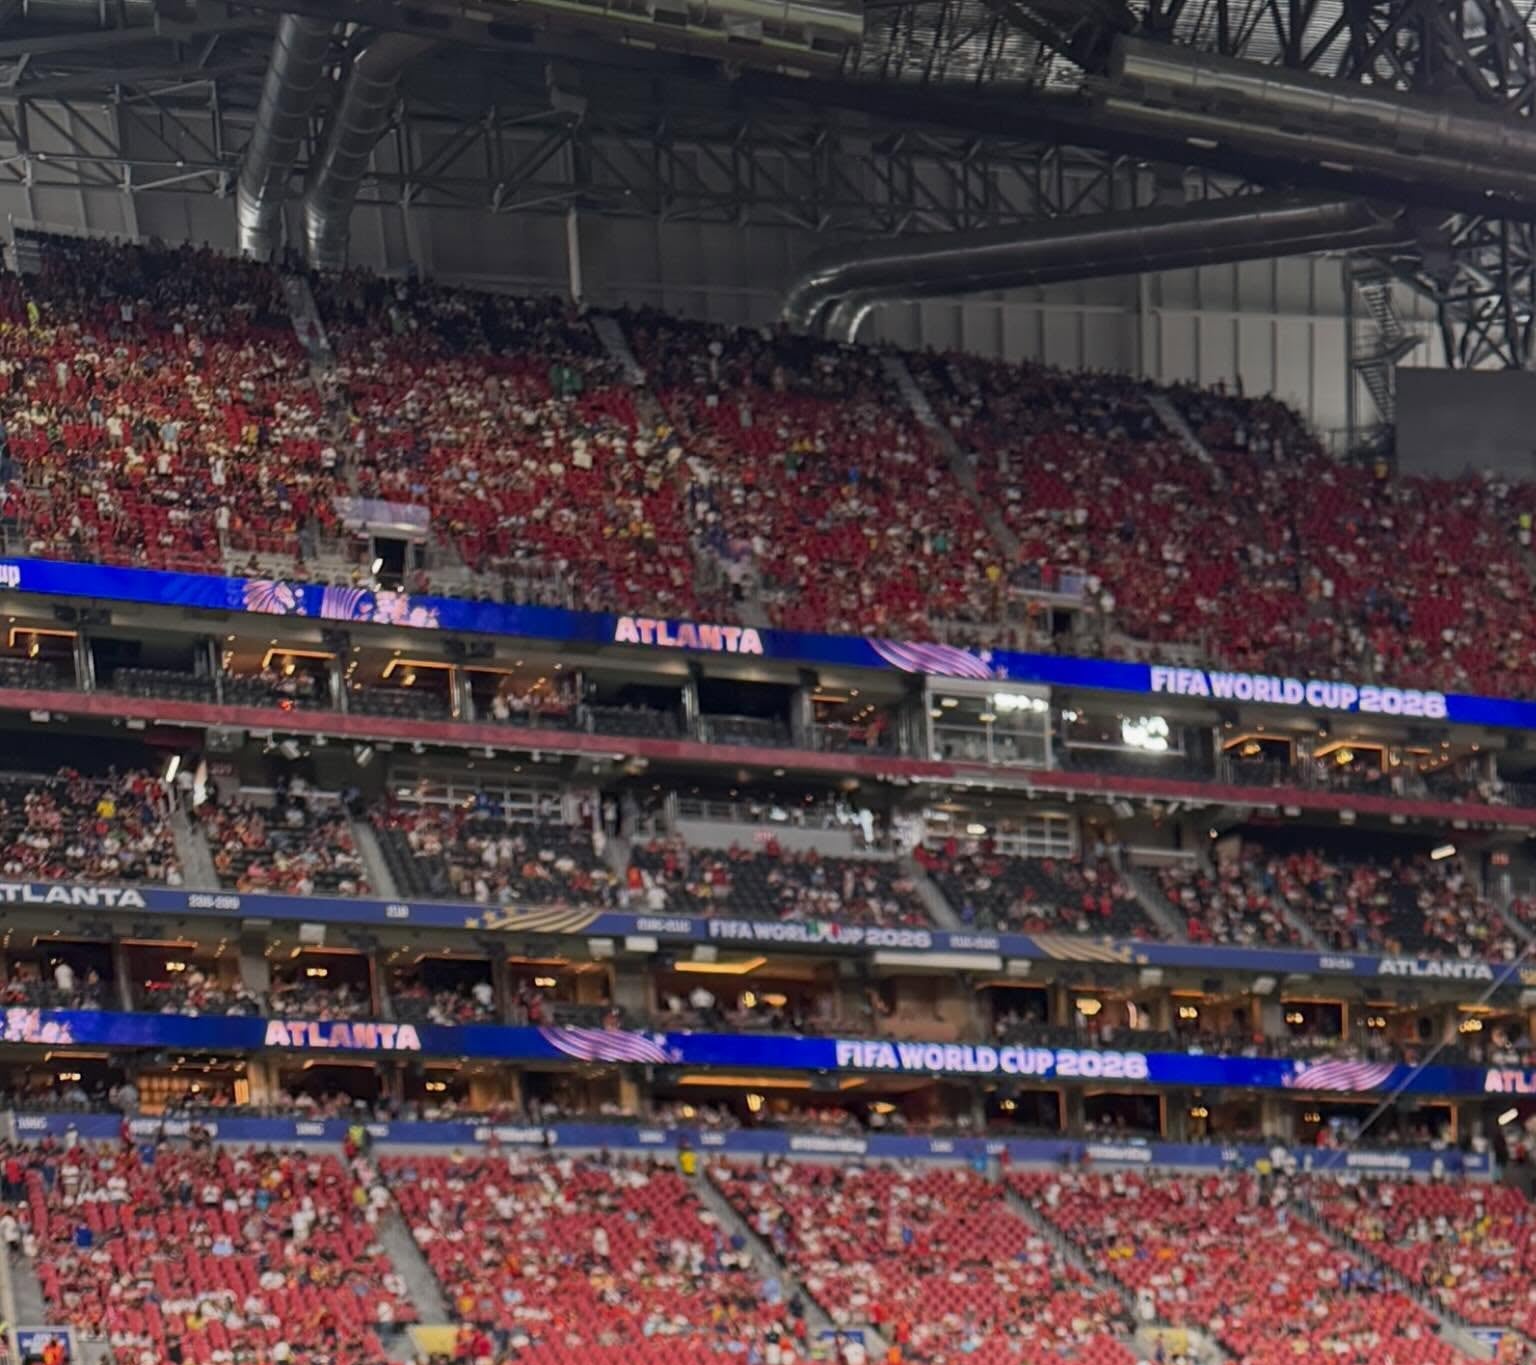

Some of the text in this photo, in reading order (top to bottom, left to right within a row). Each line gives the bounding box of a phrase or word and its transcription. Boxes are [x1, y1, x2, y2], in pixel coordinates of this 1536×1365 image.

[615, 616, 763, 654] ATLANTA
[1150, 667, 1447, 718] FIFA WORLD CUP 2026
[0, 883, 146, 908] TLANTA
[708, 920, 752, 940] FIFA
[753, 922, 819, 942] WORLD
[865, 927, 932, 948] 2026
[1378, 959, 1494, 980] ATLANTA
[265, 1020, 421, 1051] ATLANTA
[835, 1041, 1148, 1080] FIFA WORLD CUP 2026
